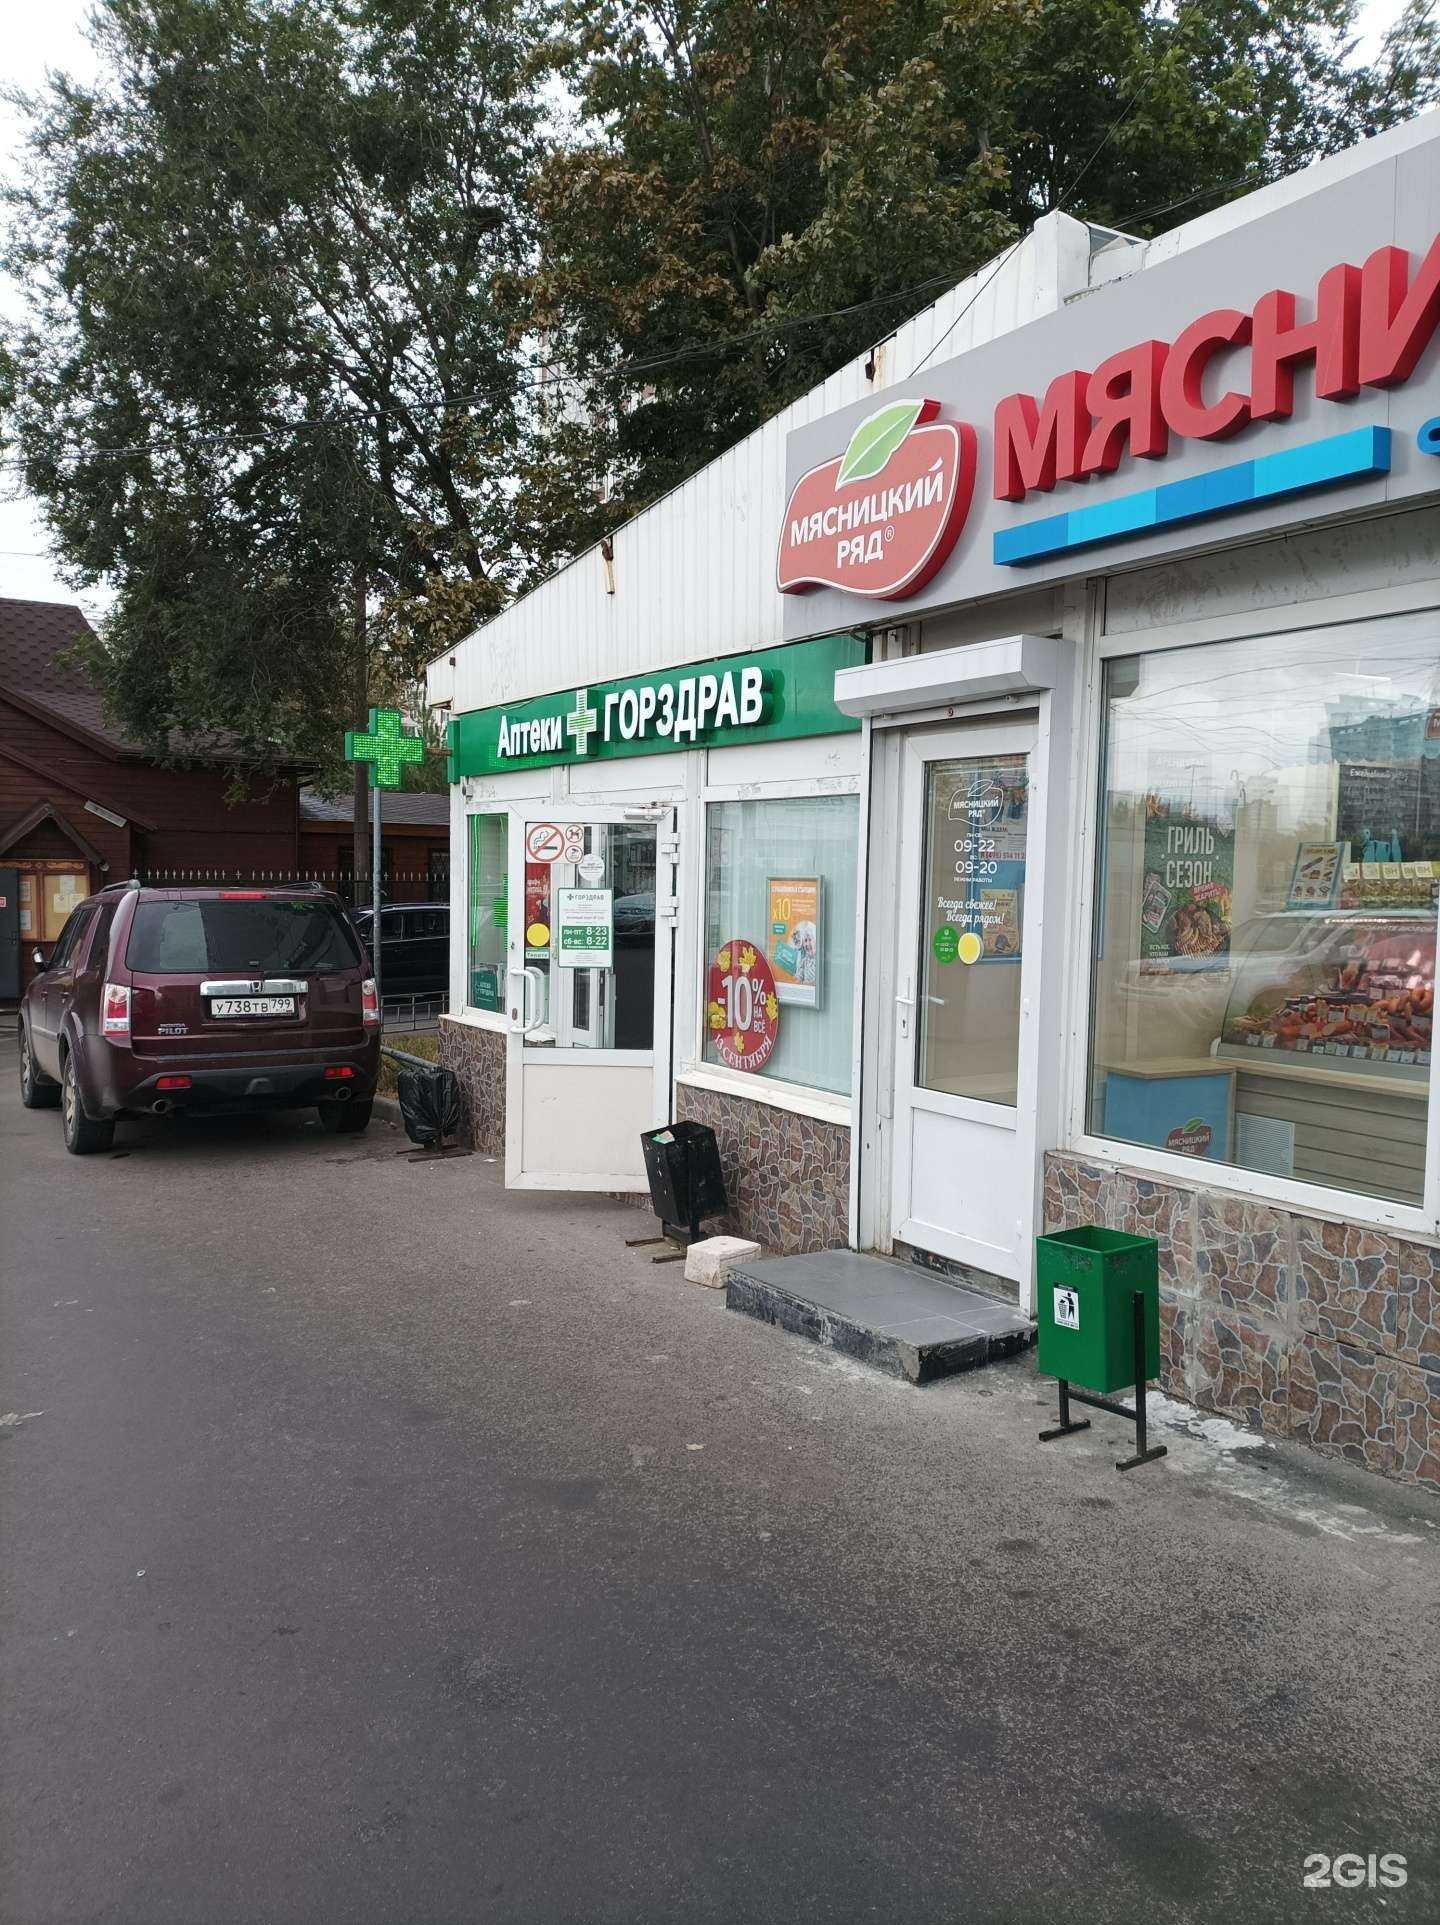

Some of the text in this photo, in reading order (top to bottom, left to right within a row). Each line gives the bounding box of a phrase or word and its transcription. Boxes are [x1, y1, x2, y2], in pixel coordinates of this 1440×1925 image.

[790, 457, 944, 548] МЯСНИЦКИЙ
[497, 666, 764, 758] Аптеки ГОРЗДРАВ
[953, 796, 999, 809] МЯСНИЦКИЙ
[954, 840, 995, 852] 09-22
[1167, 826, 1214, 855] ГРИЛЬ
[955, 861, 998, 874] 09-20
[1166, 860, 1213, 889] СЕЗОН
[937, 897, 963, 912] Всегда
[965, 898, 997, 911] свежее!
[946, 910, 1005, 928] Всегда рядом!
[586, 926, 607, 936] 8-23
[586, 936, 608, 945] 8-22
[753, 1006, 763, 1019] НА
[157, 1027, 189, 1035] PILOT
[722, 1033, 773, 1070] СЕНТЯБРЯ
